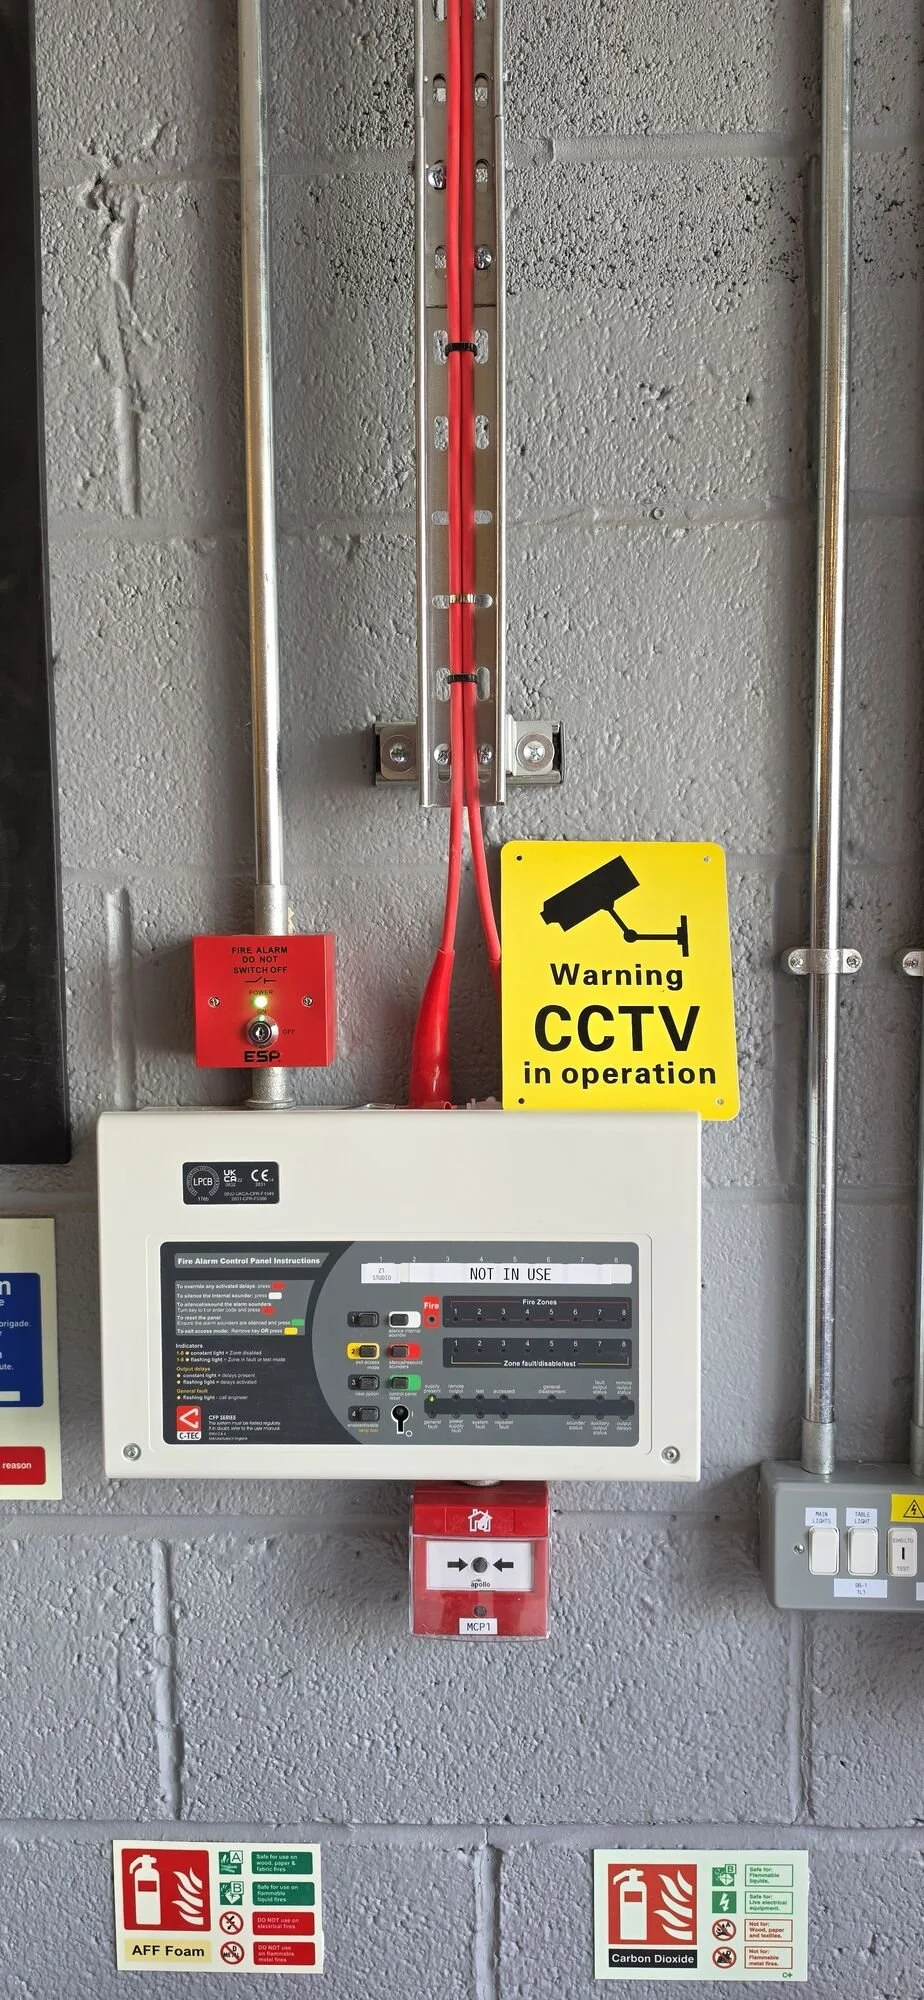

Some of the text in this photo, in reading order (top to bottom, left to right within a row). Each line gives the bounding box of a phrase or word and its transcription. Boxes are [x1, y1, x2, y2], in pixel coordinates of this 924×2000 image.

[550, 963, 683, 991] Warning
[534, 1005, 700, 1052] CCTV
[244, 1051, 280, 1062] ESP
[524, 1061, 716, 1089] in operation
[194, 1178, 213, 1186] LPCB
[470, 1268, 551, 1280] NOT IN USE
[2, 1461, 32, 1470] reason
[466, 1622, 491, 1631] MCP1
[232, 1853, 241, 1862] A
[233, 1884, 241, 1892] B
[132, 1945, 205, 1957] AFF Foam
[612, 1953, 694, 1964] Carbon Dioxide
